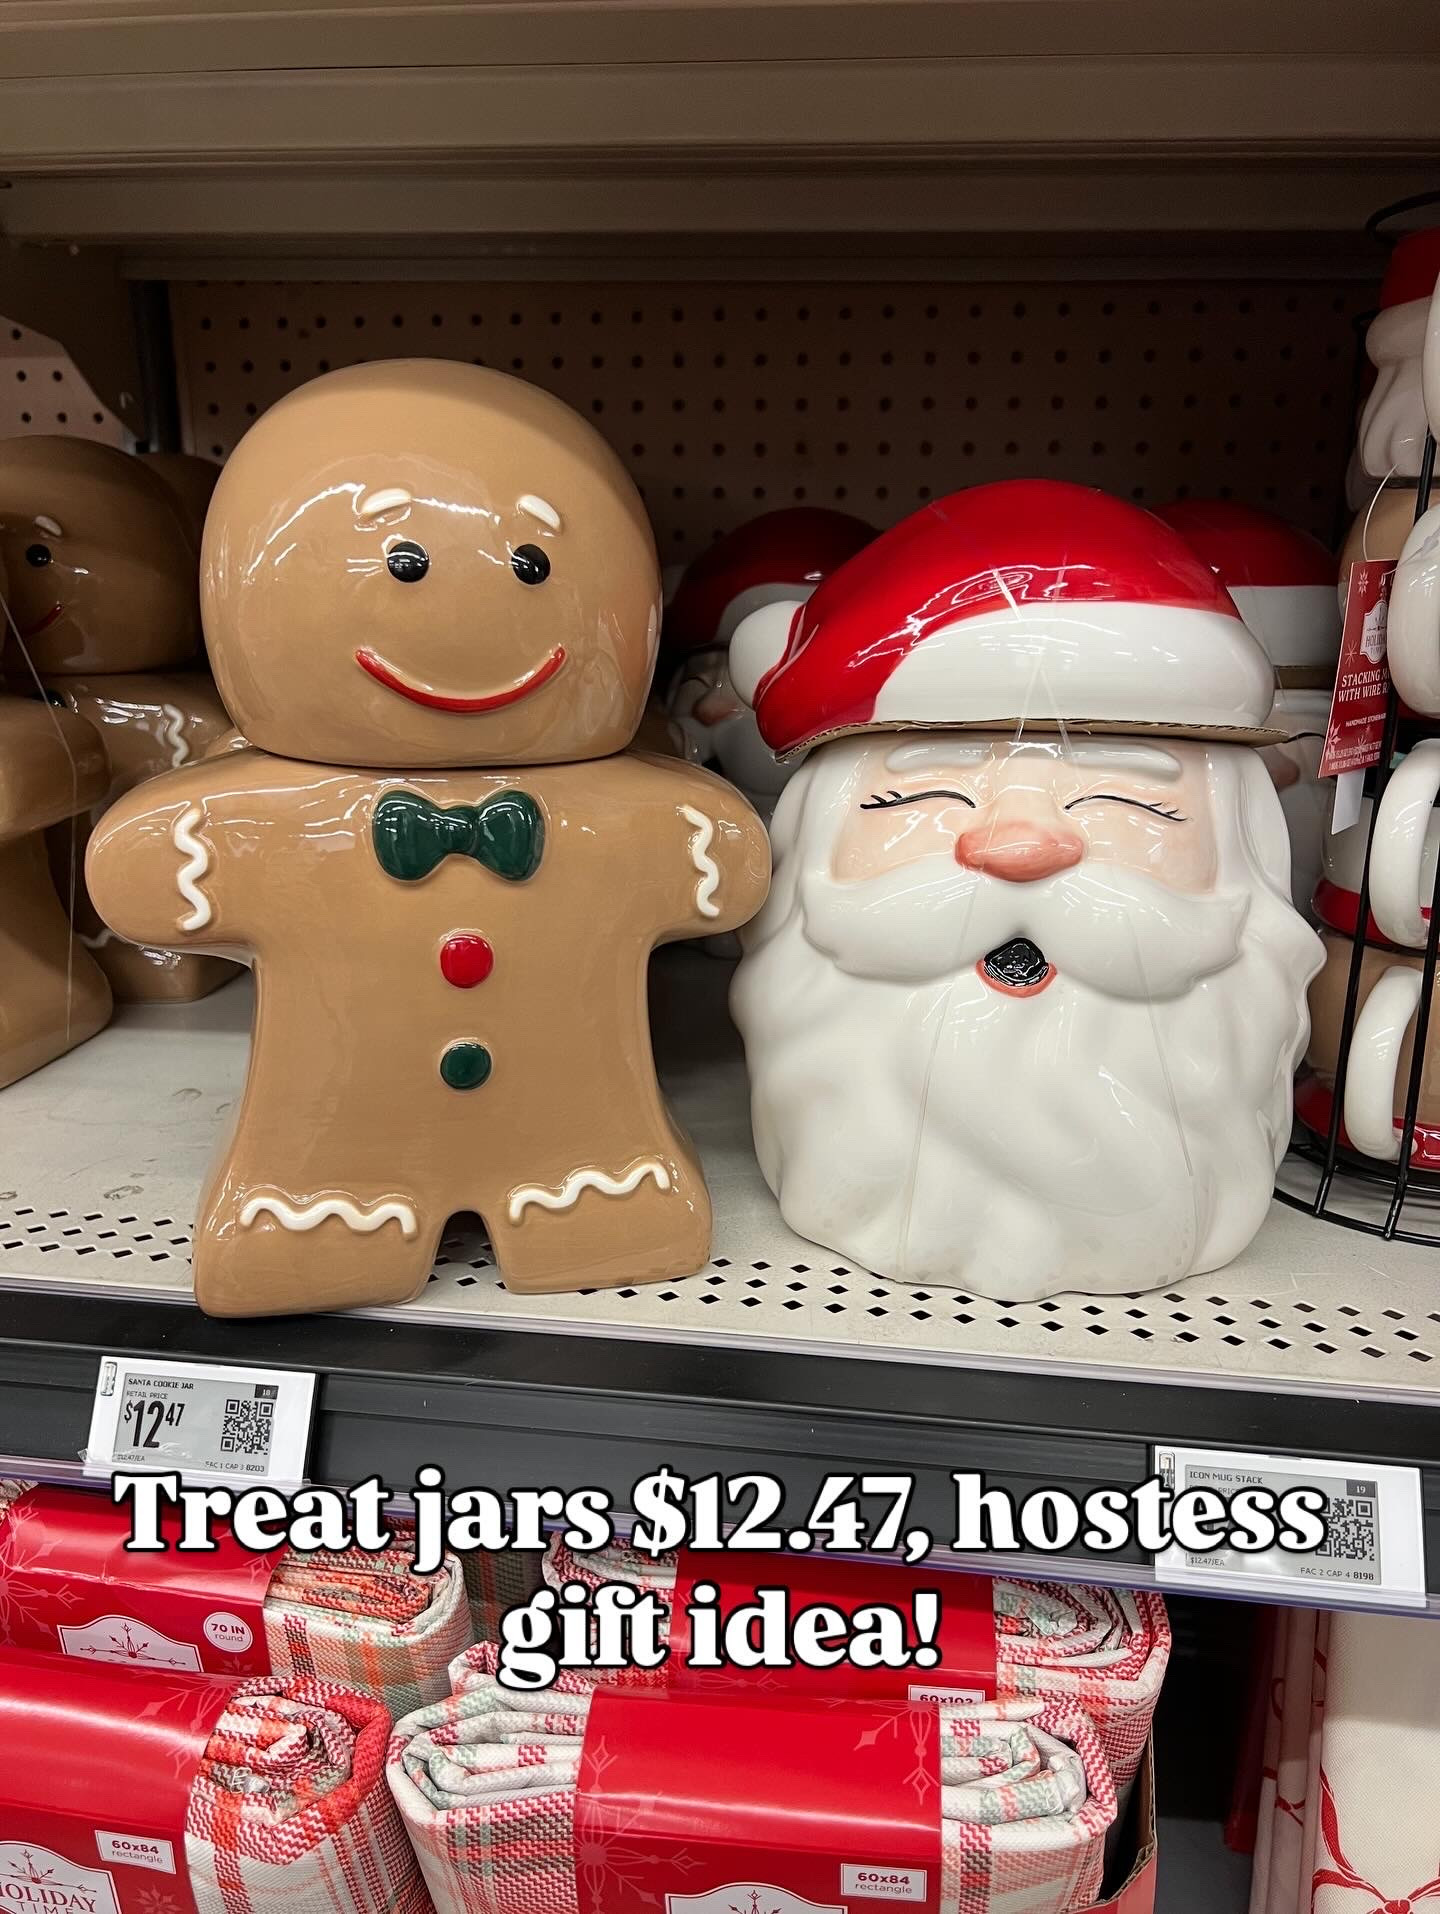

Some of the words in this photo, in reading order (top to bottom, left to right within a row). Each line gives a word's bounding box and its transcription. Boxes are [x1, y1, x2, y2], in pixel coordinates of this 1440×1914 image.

[1341, 668, 1381, 688] STACKING
[1338, 687, 1361, 703] WITH
[1362, 684, 1382, 699] WIRE
[128, 1378, 151, 1387] SANTA
[153, 1380, 179, 1389] COOKIE
[181, 1382, 194, 1390] JAR
[126, 1390, 147, 1399] RETAIL
[149, 1391, 168, 1400] PRICE
[1189, 1471, 1211, 1480] ICON
[1212, 1473, 1233, 1482] MUG
[1235, 1475, 1263, 1485] STACK
[1356, 1485, 1366, 1494] 19
[1190, 1556, 1225, 1567] $12.47/EA
[1300, 1567, 1317, 1576] FAC
[1326, 1569, 1343, 1578] CAP
[1353, 1571, 1374, 1581] 8198
[211, 1623, 226, 1634] 70
[229, 1625, 245, 1636] IN
[214, 1633, 244, 1643] round
[111, 1839, 160, 1855] 60x84
[111, 1849, 164, 1865] rectangle
[857, 1872, 911, 1886] 60x84
[855, 1883, 913, 1895] rectangle
